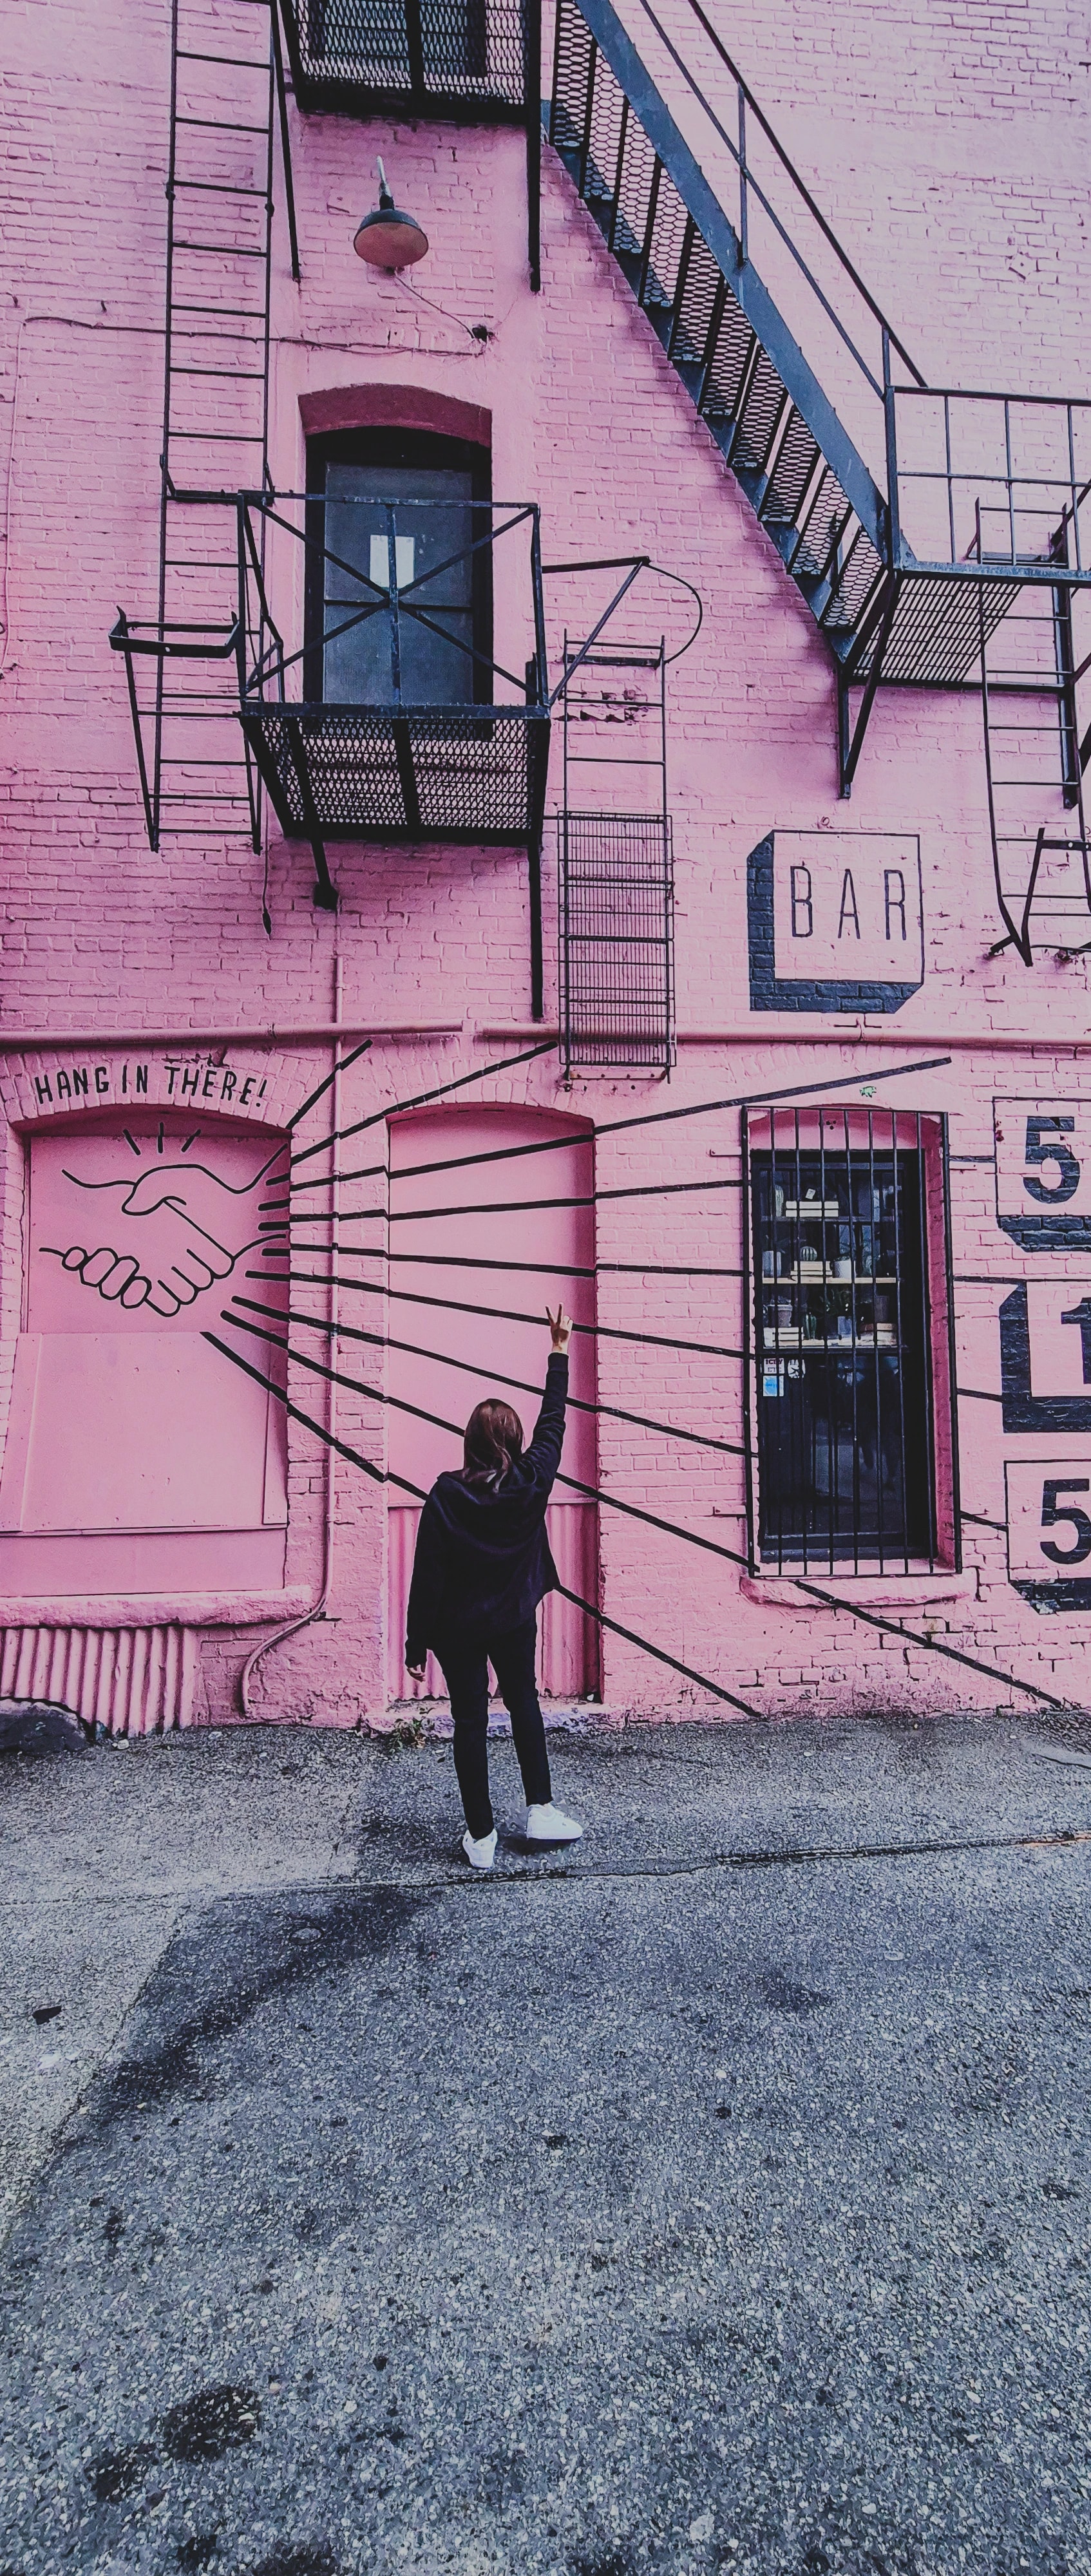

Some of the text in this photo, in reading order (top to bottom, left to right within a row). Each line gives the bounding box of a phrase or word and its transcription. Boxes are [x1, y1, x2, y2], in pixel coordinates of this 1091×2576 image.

[790, 866, 907, 940] BAR
[35, 1065, 267, 1107] HANG IN THERE!
[1023, 1116, 1080, 1204] 5
[1040, 1479, 1091, 1565] 5
